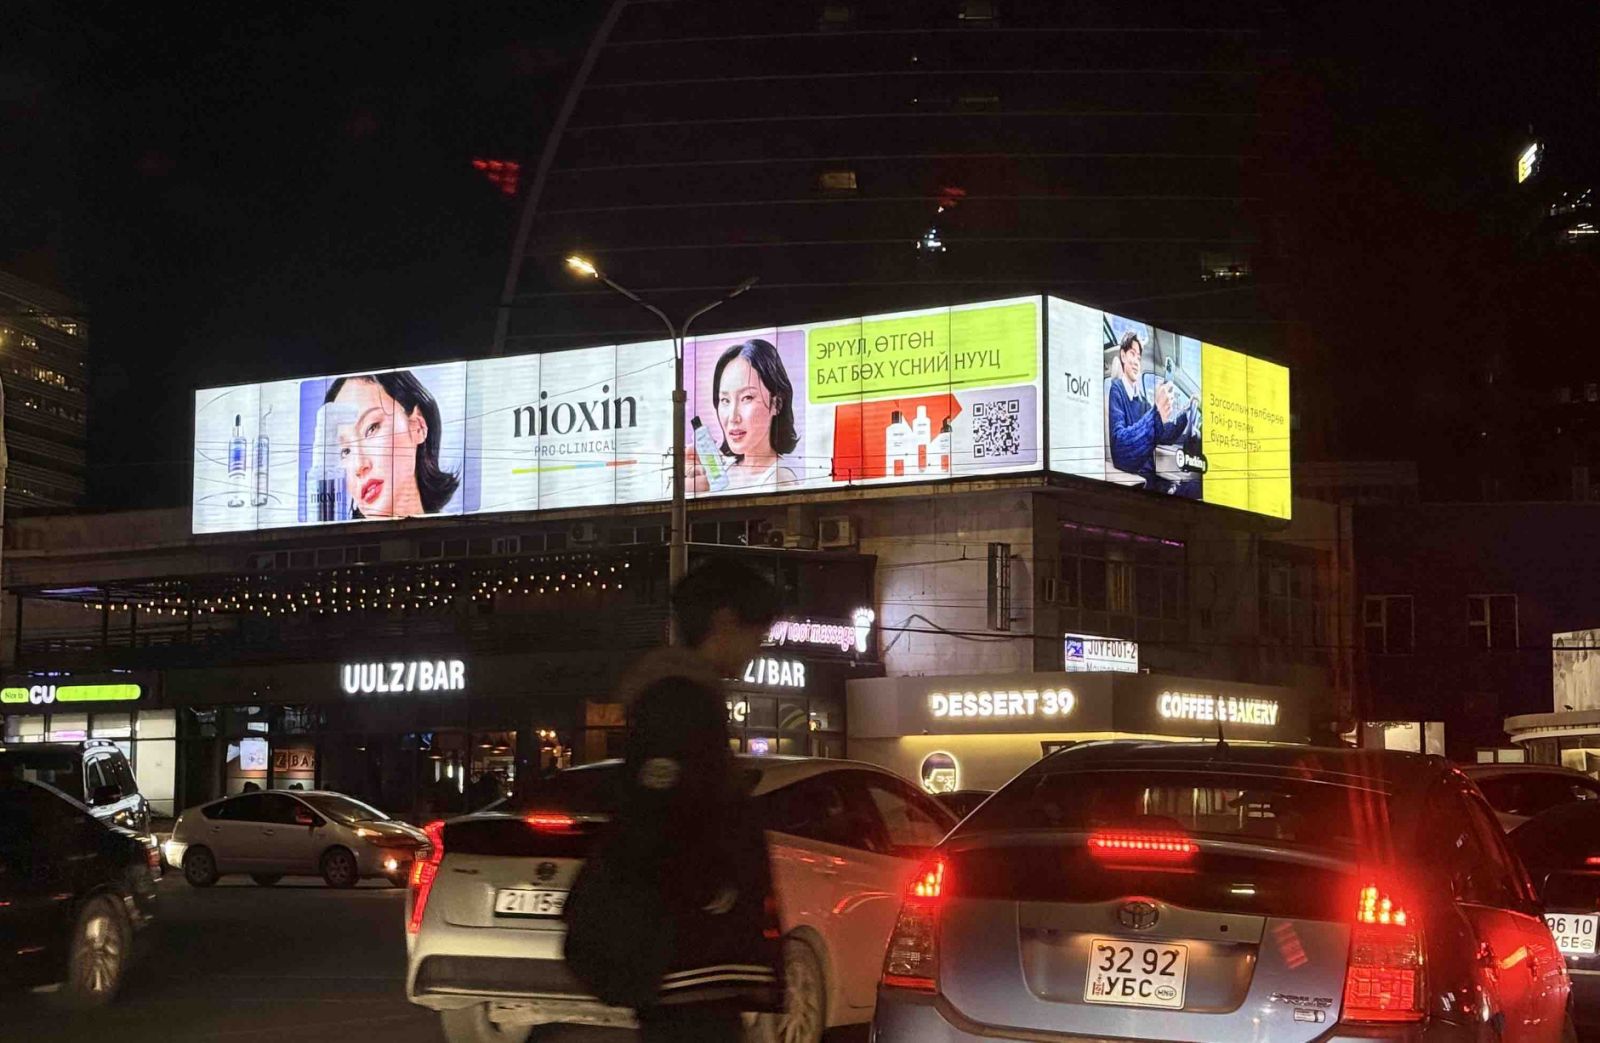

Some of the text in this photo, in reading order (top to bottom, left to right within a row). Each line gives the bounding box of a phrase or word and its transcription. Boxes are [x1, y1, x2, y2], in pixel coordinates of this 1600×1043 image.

[875, 330, 933, 350] ӨТГӨН
[817, 349, 1001, 385] БАТ БӨХ ҮСНИЙ НУУЦ
[1064, 371, 1089, 398] Toki
[513, 384, 638, 438] nioxin
[534, 440, 617, 456] PRO CLINICAL
[344, 660, 465, 694] UULZ/BAR
[29, 685, 56, 704] CU
[931, 688, 1075, 718] DESSERT 39
[1158, 692, 1214, 720] COFFEE
[1574, 918, 1592, 935] 10
[1556, 935, 1579, 948] БЕ
[1098, 945, 1180, 976] 32 92
[1105, 976, 1153, 997] УБС
